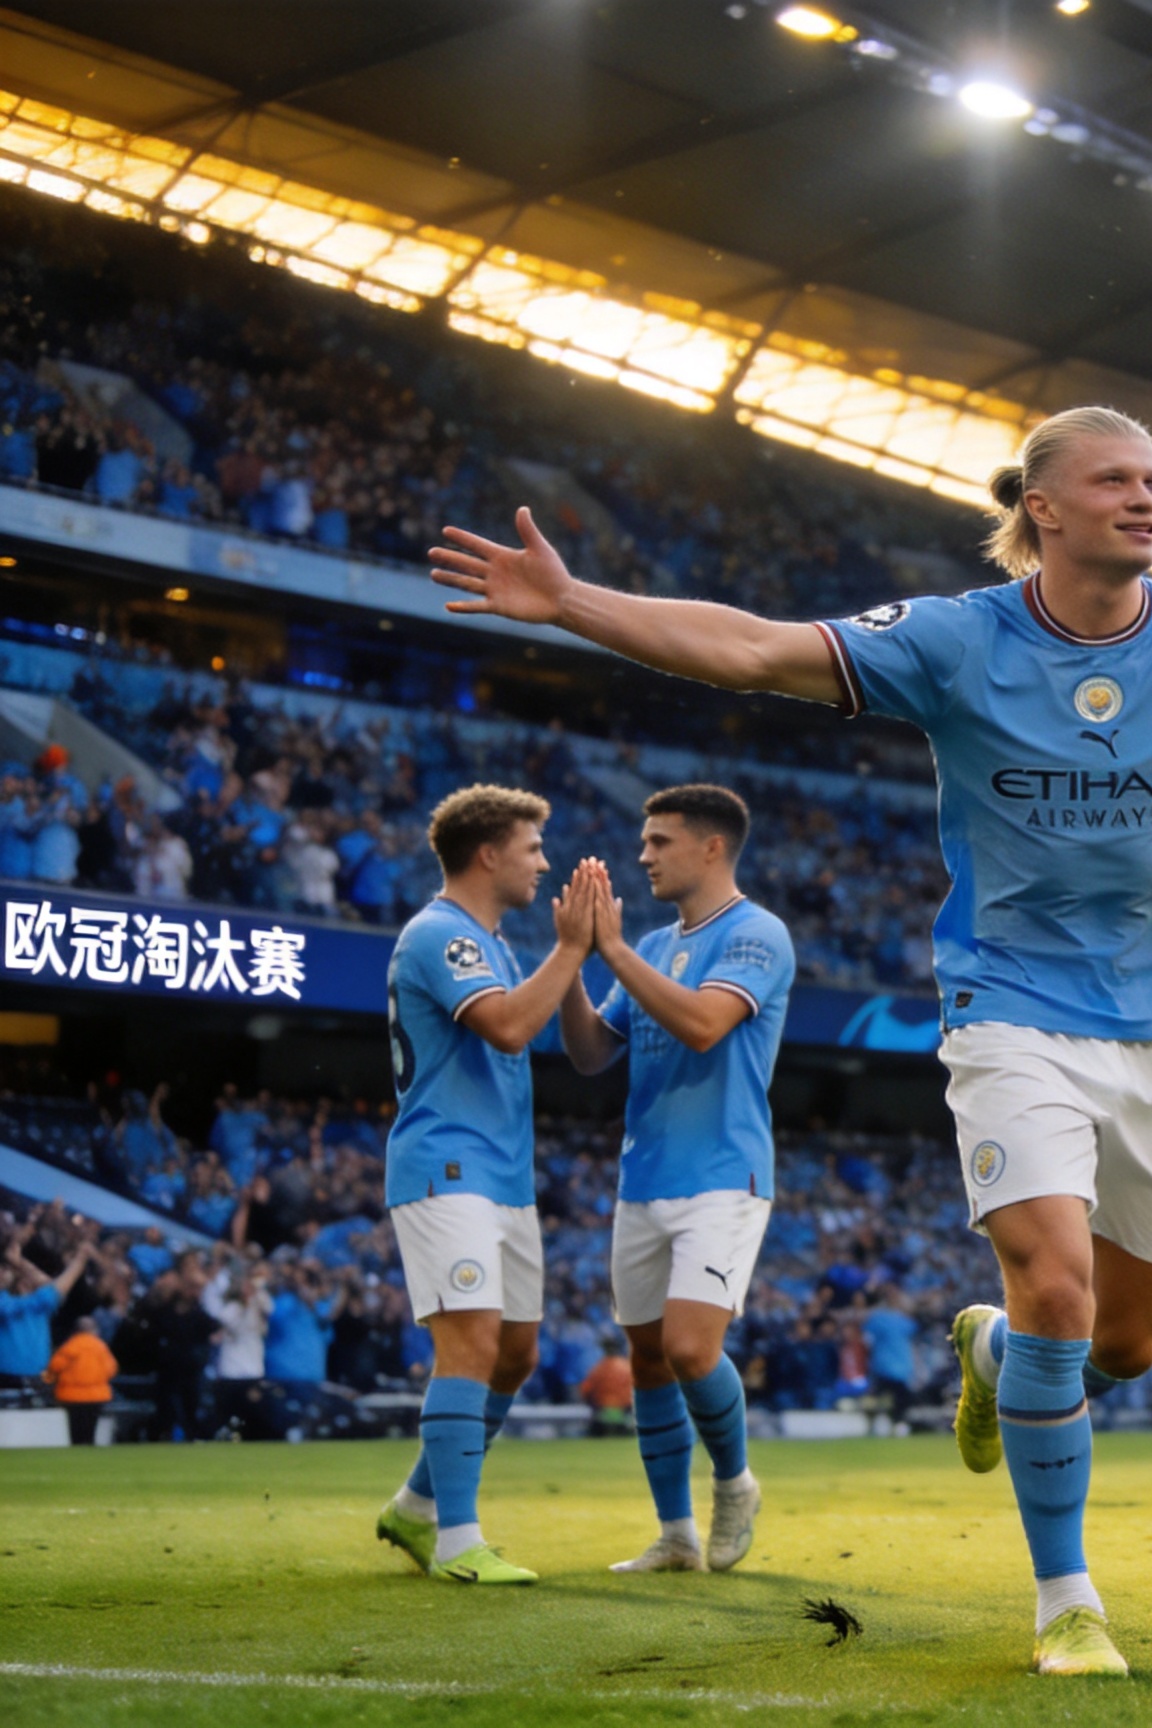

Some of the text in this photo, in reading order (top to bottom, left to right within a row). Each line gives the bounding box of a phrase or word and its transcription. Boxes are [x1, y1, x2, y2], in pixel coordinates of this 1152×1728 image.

[5, 900, 306, 1001] 欧冠淘汰赛
